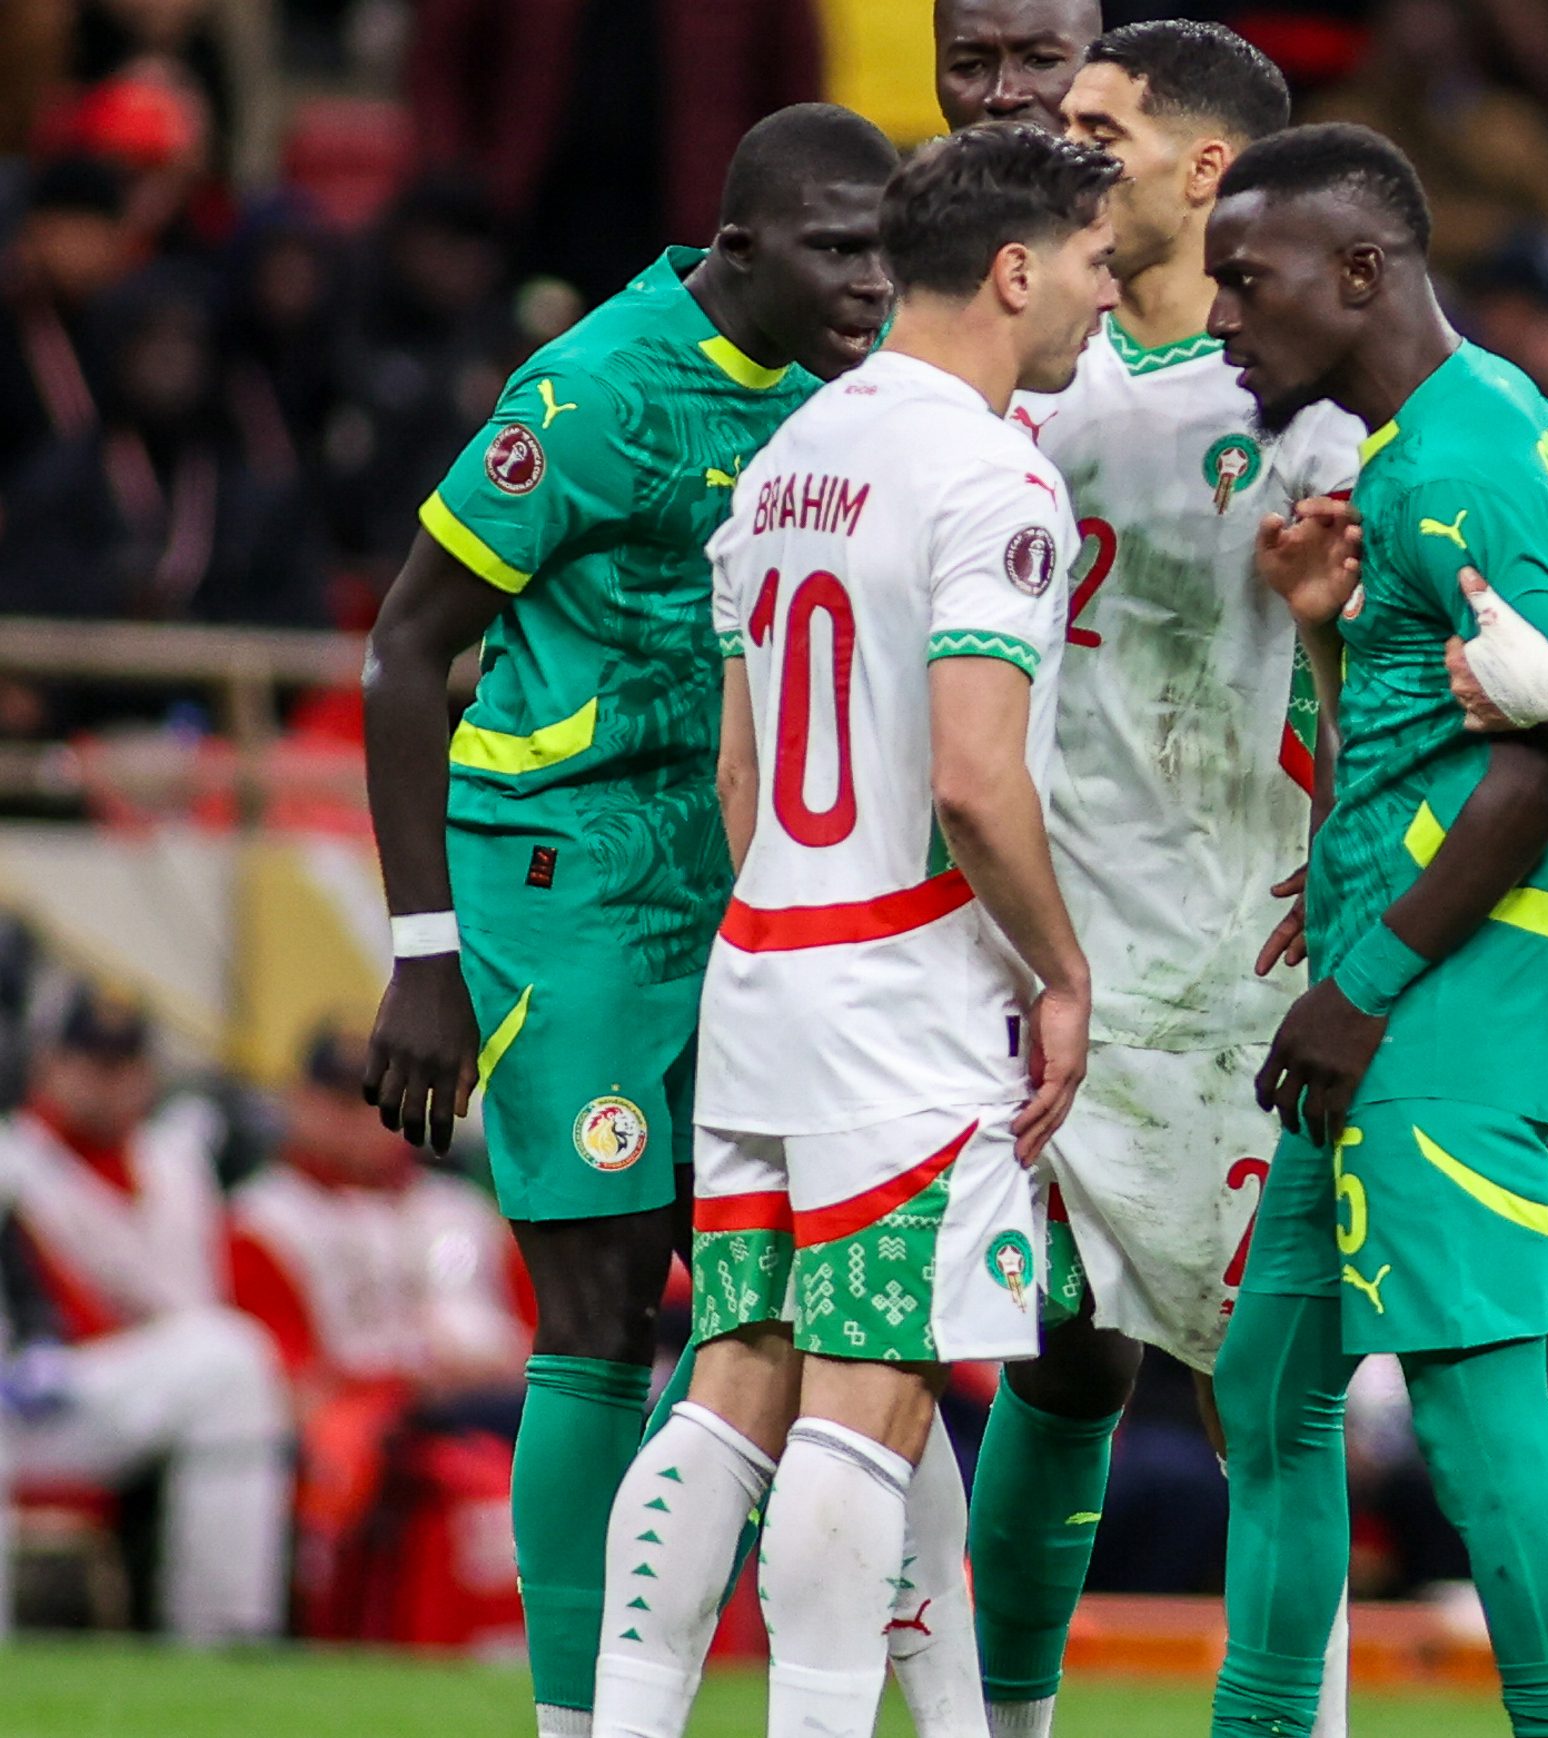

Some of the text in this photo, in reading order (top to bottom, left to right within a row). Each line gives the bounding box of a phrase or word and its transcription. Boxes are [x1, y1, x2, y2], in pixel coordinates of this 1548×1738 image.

[753, 472, 871, 536] BRAHIM
[1066, 516, 1118, 649] 2
[748, 566, 857, 848] 10
